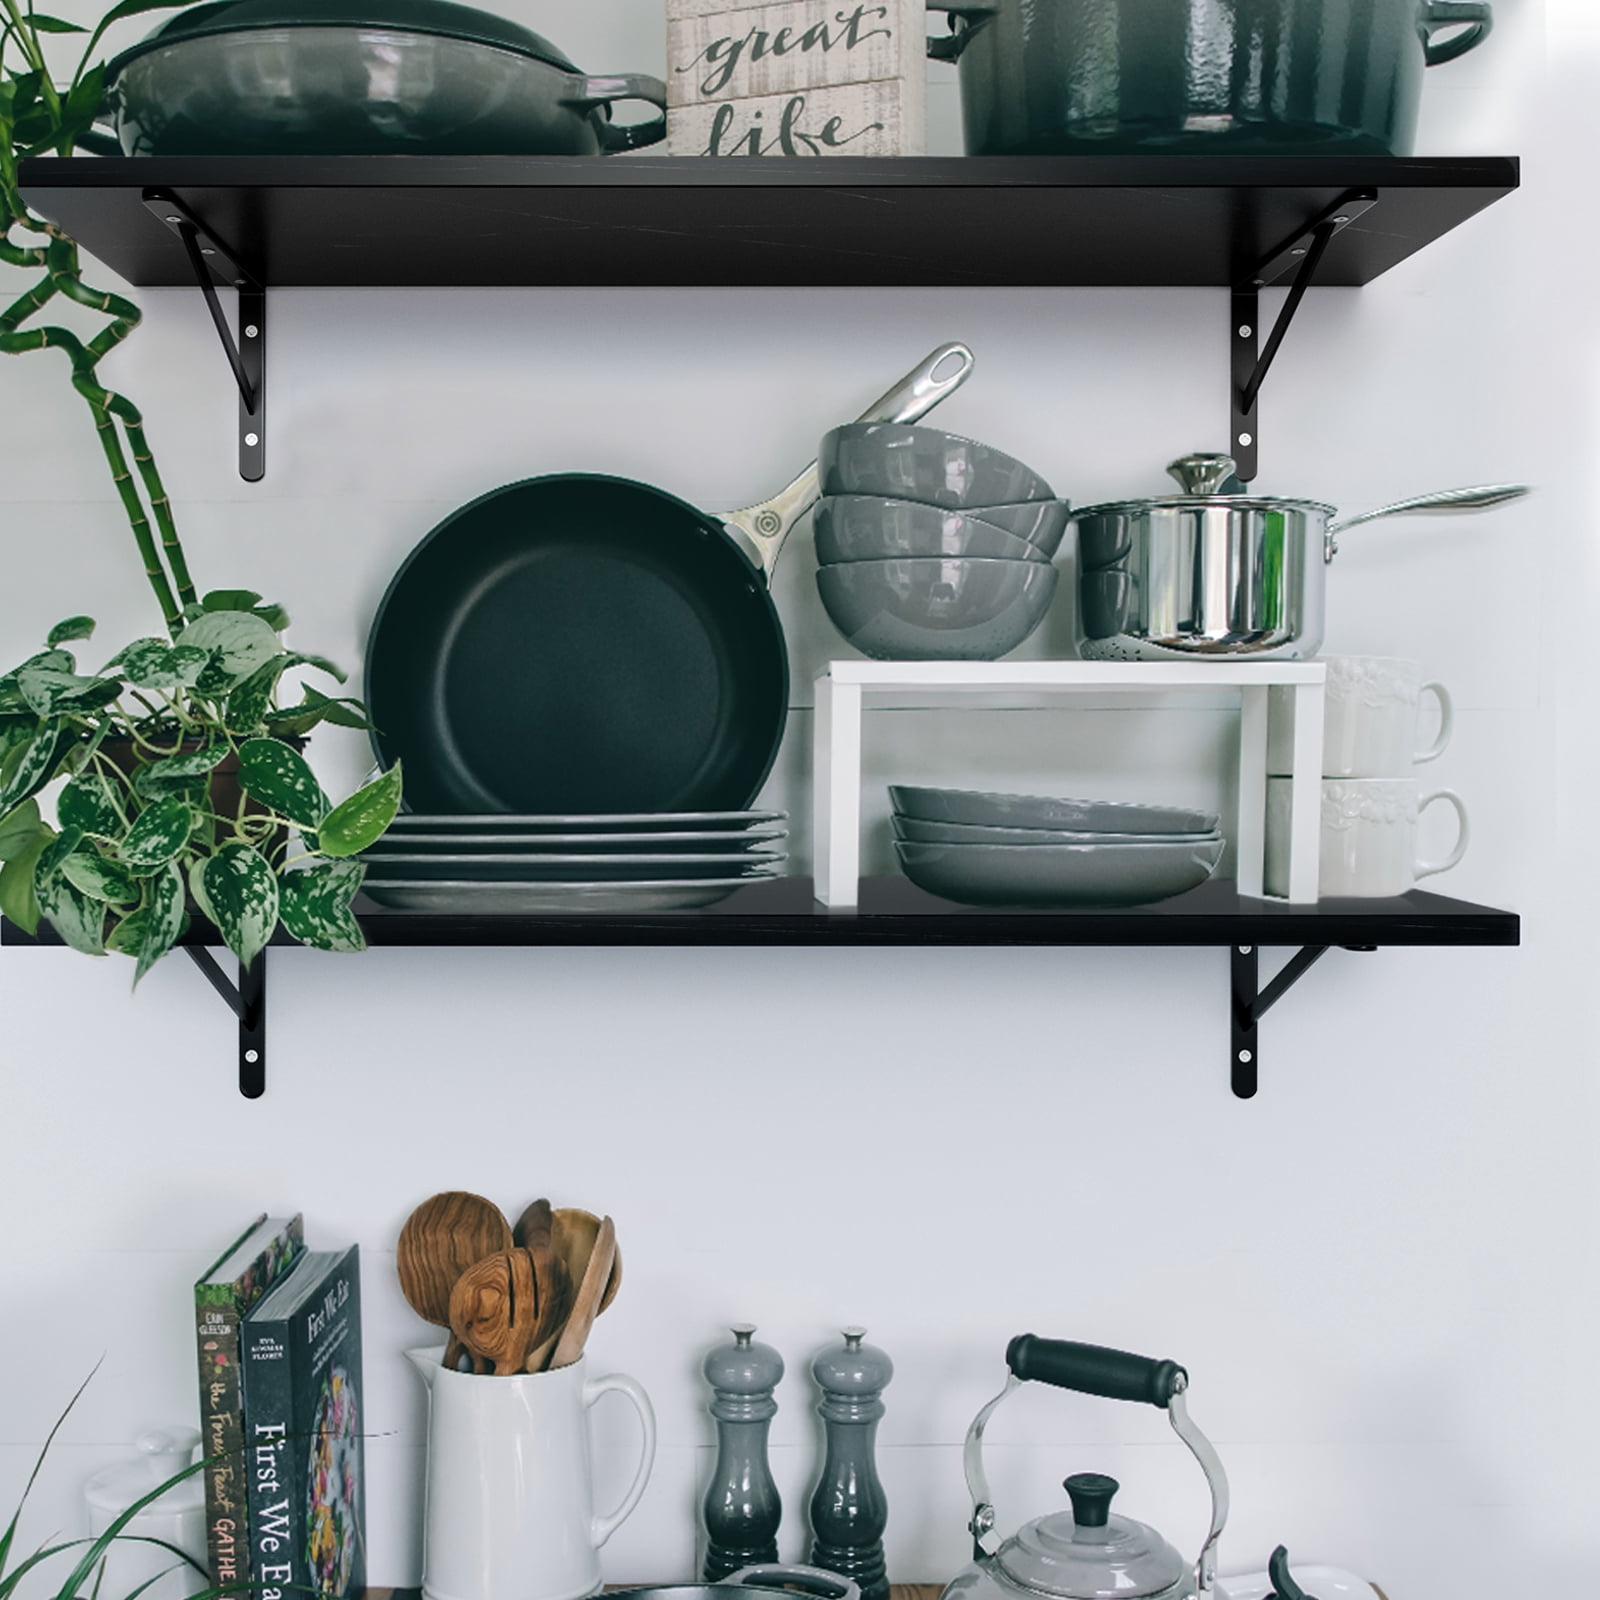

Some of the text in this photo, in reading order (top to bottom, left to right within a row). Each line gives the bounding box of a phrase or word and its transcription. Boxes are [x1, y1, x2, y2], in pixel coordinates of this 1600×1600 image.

[675, 4, 892, 96] great
[700, 96, 884, 156] life
[213, 1466, 235, 1513] Feast
[255, 1422, 287, 1493] First
[259, 1498, 290, 1553] We
[212, 1518, 237, 1600] GATHE
